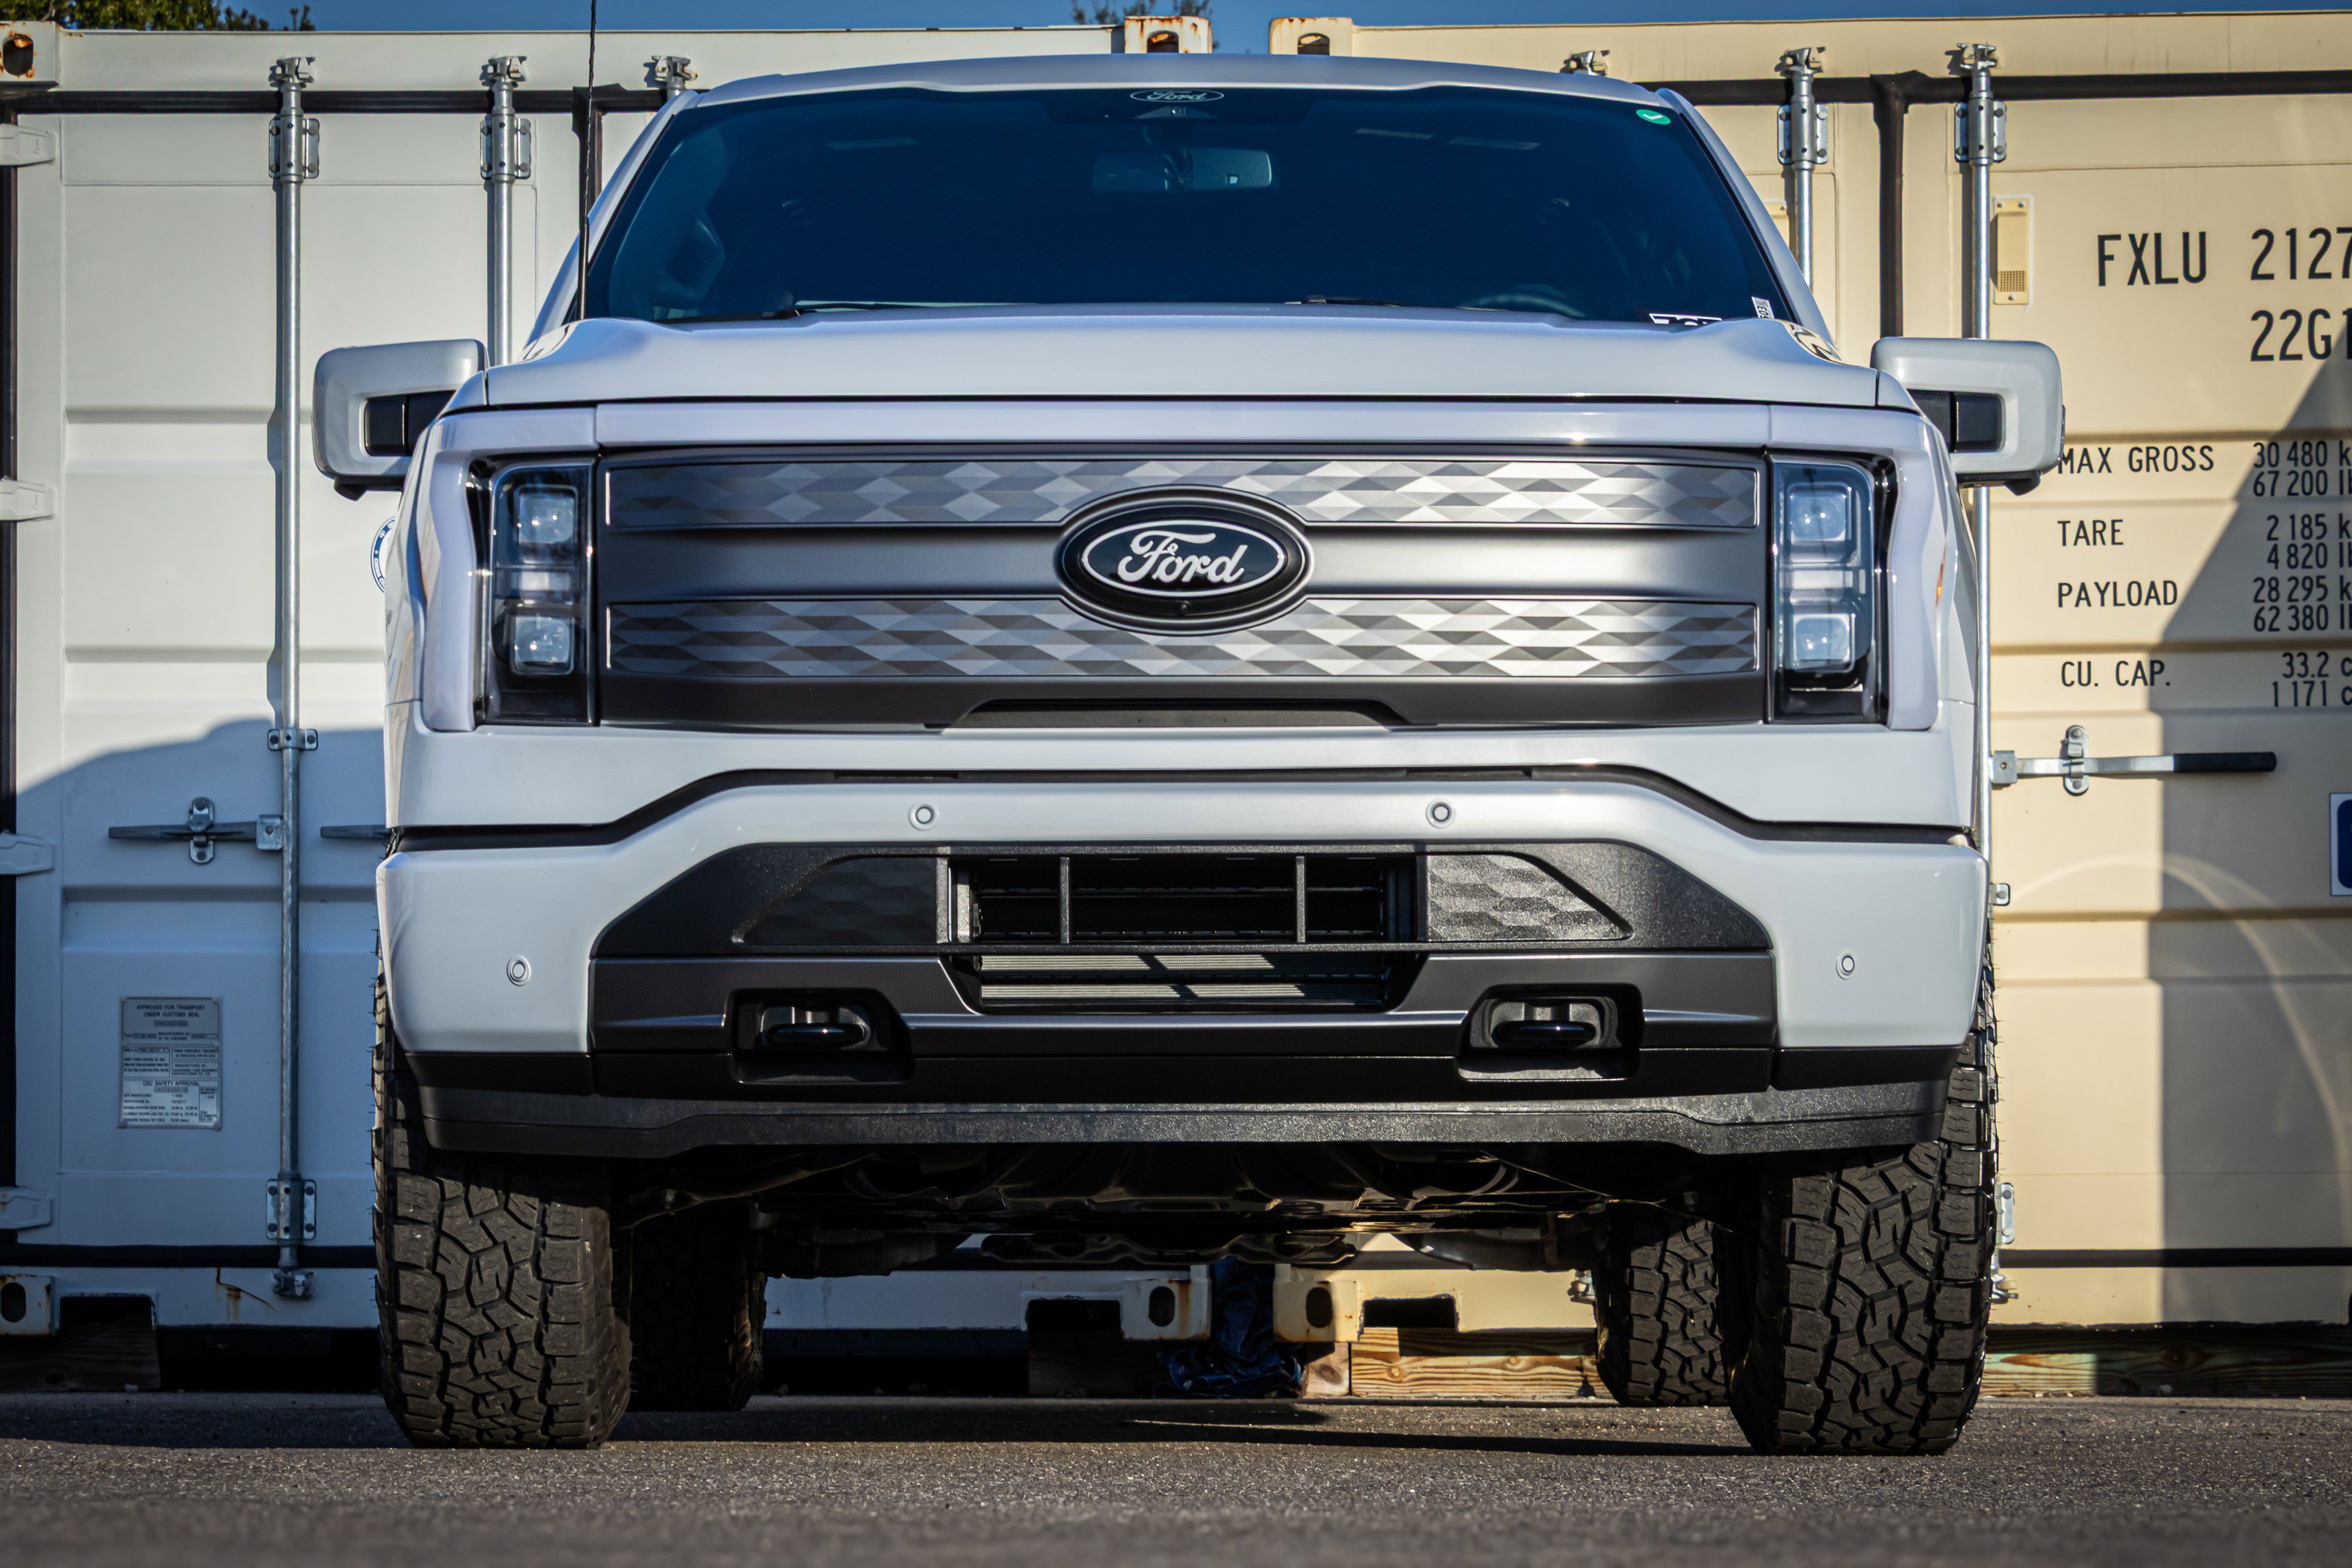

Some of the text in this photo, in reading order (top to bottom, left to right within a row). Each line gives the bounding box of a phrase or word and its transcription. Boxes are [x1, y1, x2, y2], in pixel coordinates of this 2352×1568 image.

[1146, 90, 1207, 101] Ford
[2097, 226, 2352, 287] FXLU 2127
[2251, 308, 2352, 362] 22G1
[2057, 447, 2112, 475] MAX
[2128, 445, 2214, 473] GROSS
[2057, 519, 2125, 546] TARE
[1117, 530, 1248, 583] Ford
[2057, 580, 2178, 608] PAYLOAD
[2060, 661, 2099, 687] CU.
[2115, 660, 2172, 687] CAP.
[2282, 651, 2330, 679] 33.2
